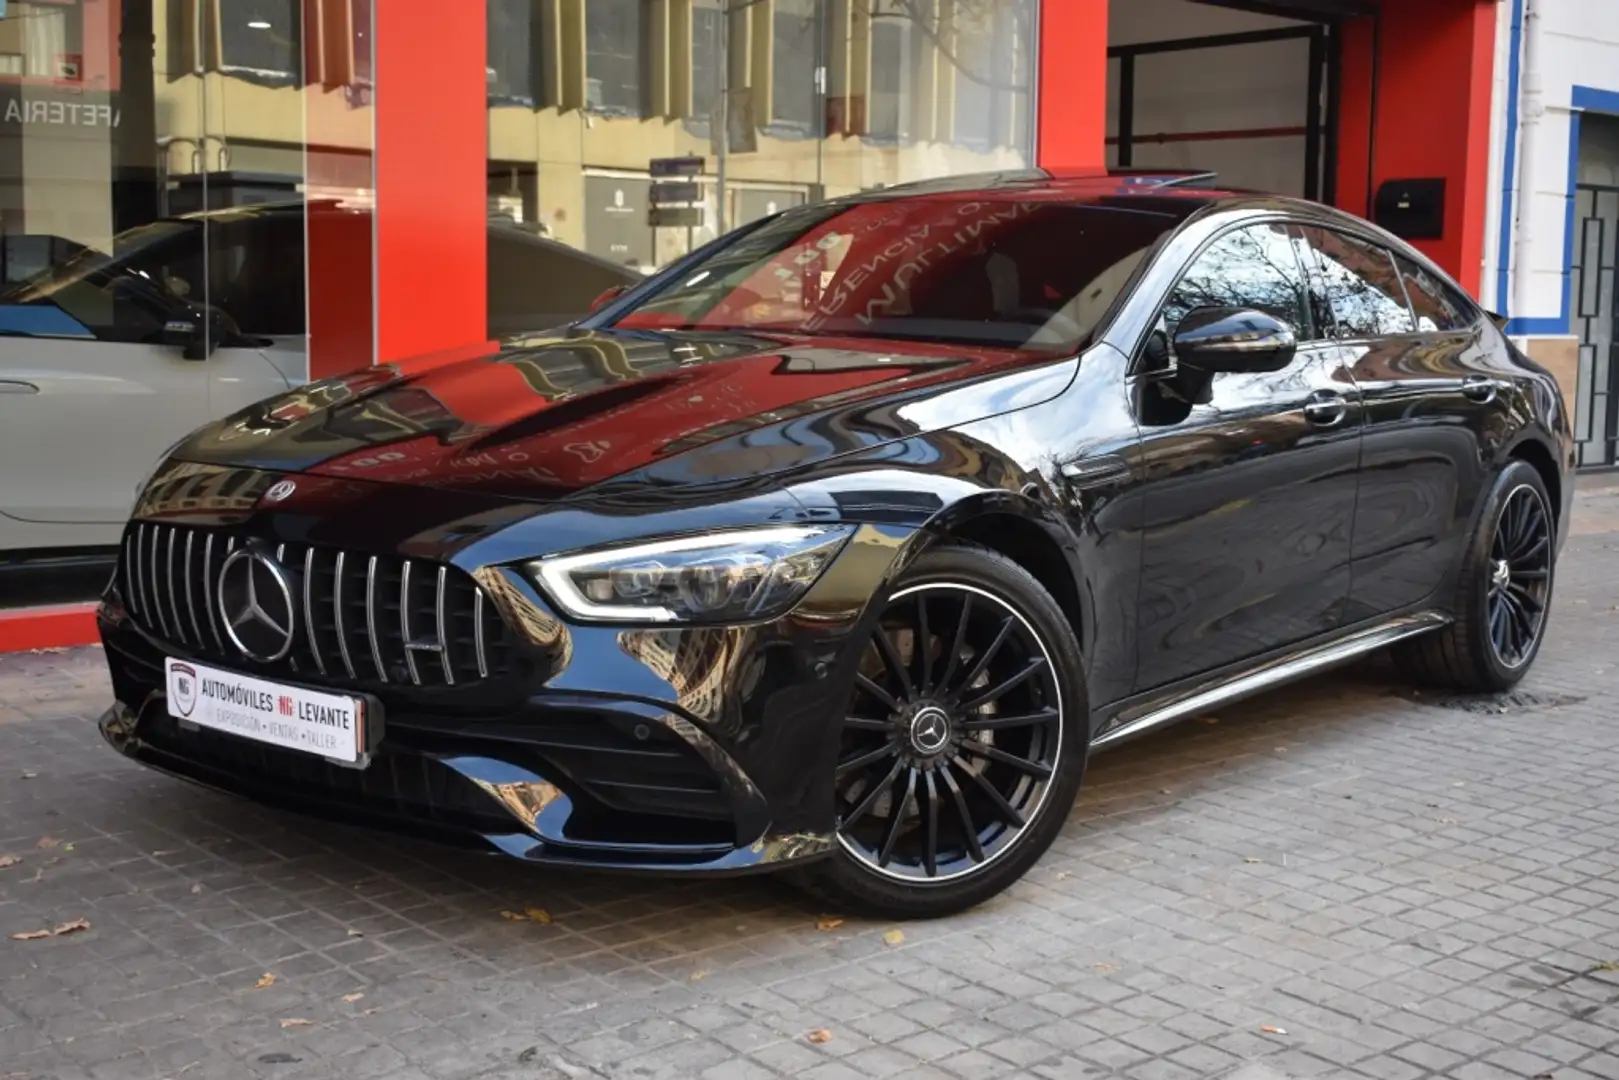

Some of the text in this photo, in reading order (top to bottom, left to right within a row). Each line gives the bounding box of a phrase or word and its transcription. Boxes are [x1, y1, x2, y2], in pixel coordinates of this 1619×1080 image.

[201, 678, 274, 714] AUTOMÓVILES
[298, 699, 349, 730] LEVANTE
[268, 721, 300, 742] VENTAS
[306, 729, 338, 750] TALLER
